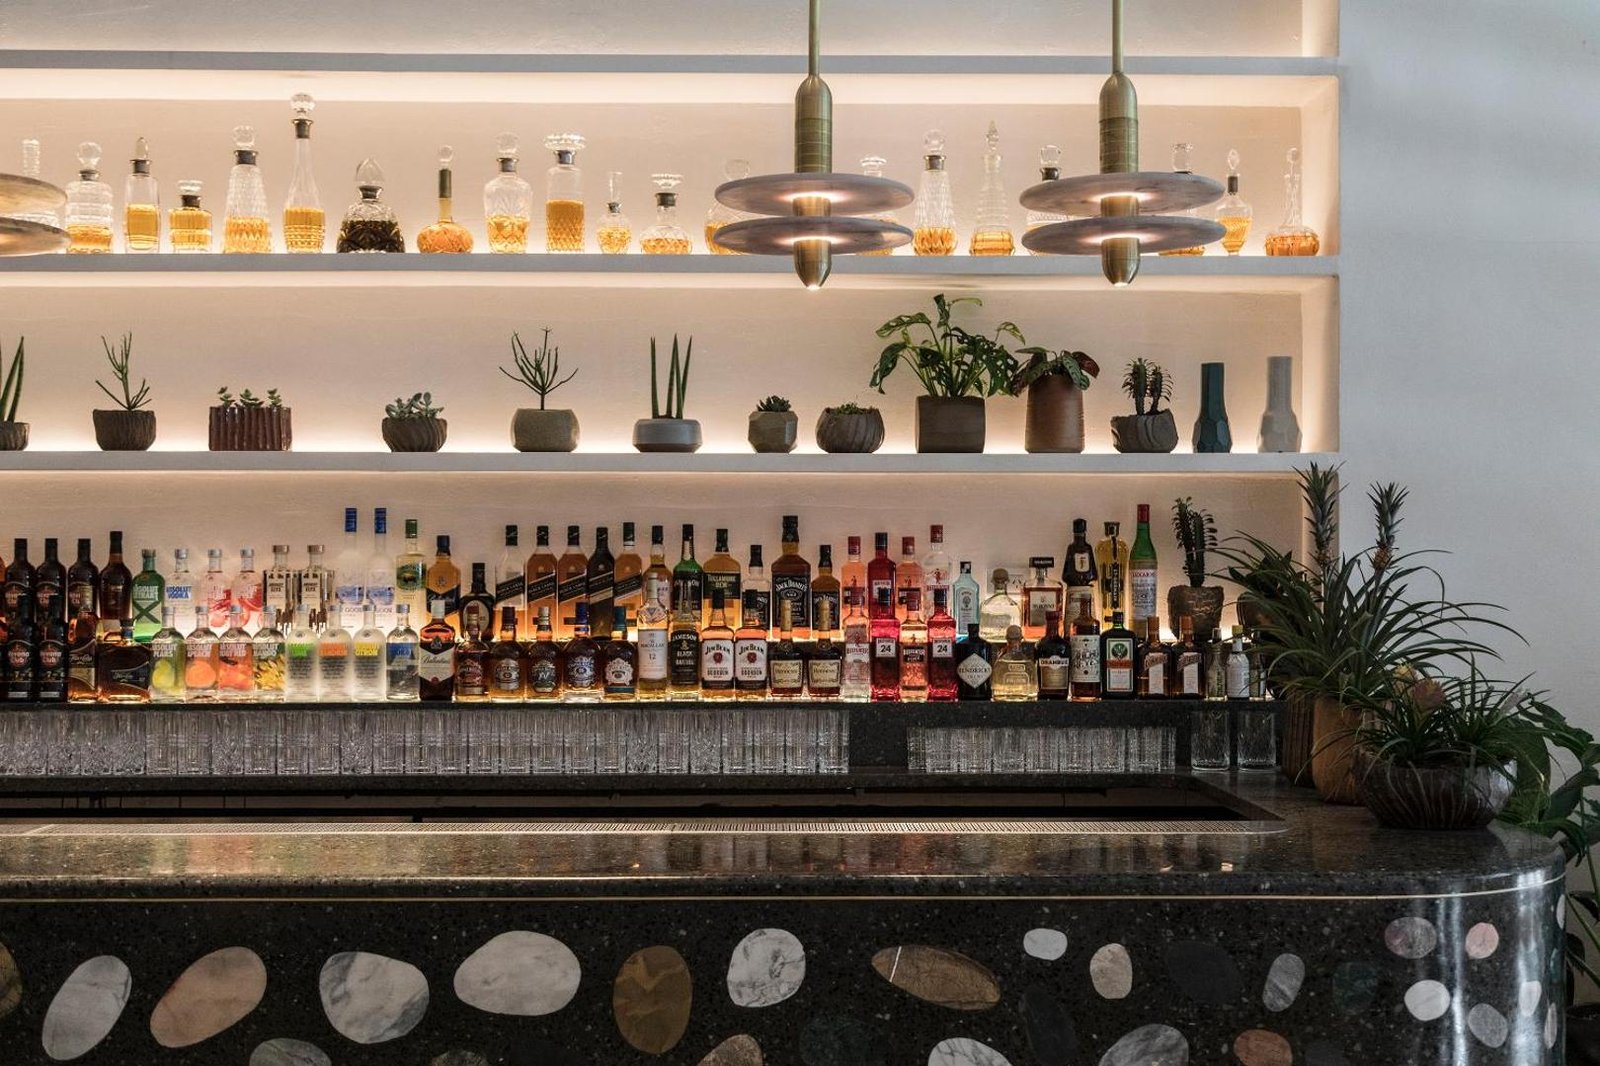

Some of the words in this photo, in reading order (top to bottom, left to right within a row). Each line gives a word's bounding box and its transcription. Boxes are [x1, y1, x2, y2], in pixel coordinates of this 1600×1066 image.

[775, 582, 788, 592] JACK
[672, 633, 697, 641] JAMESON
[880, 645, 891, 653] 24
[937, 645, 948, 653] 24
